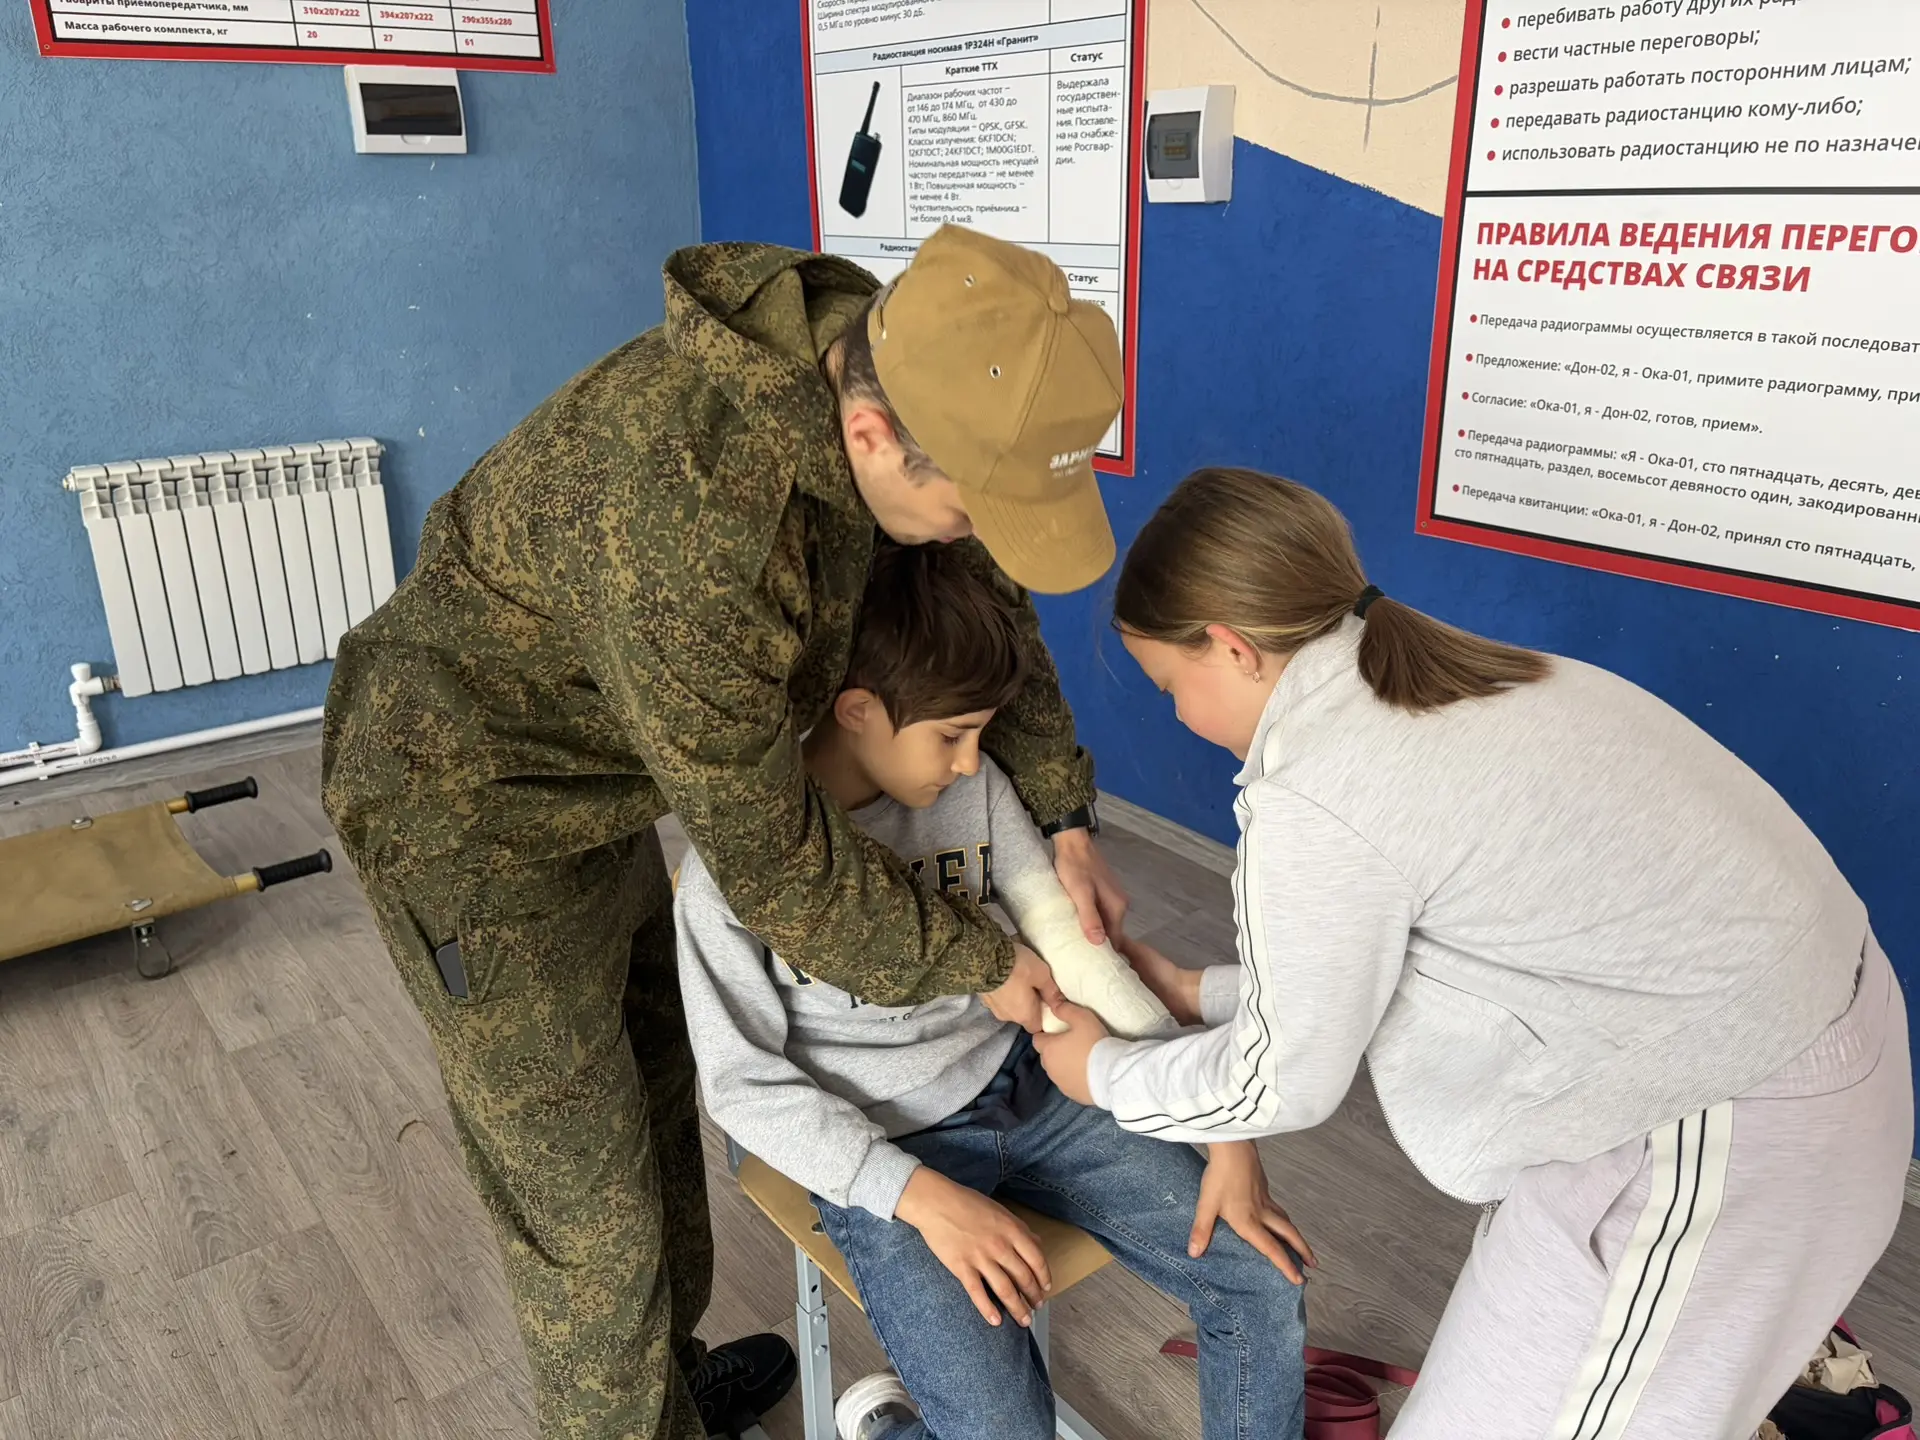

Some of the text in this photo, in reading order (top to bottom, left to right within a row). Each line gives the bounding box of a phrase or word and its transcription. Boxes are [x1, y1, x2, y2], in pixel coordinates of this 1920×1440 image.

[64, 21, 99, 30] Масса
[101, 23, 152, 33] рабочего
[1517, 7, 1615, 28] перебивать
[1620, 0, 1683, 22] работу
[307, 30, 318, 38] 20
[383, 34, 393, 42] 27
[465, 38, 474, 46] 61
[873, 49, 926, 61] Радиостанция
[927, 44, 962, 54] носимая
[996, 35, 1039, 47] «Гранит»
[1514, 30, 1760, 61] вести частные переговоры;
[945, 62, 998, 76] Краткие ТТХ
[1070, 52, 1103, 63] Статус
[1509, 57, 1912, 99] разрешать работать посторонним лицам;
[1506, 96, 1863, 130] передавать радиостанцию кому-либо;
[1502, 137, 1920, 161] использовать радиостанцию не по назначе
[1477, 222, 1920, 253] ПРАВИЛА ВЕДЕНИЯ ПЕРЕГО
[1067, 273, 1098, 285] Статус
[1473, 258, 1811, 292] НА СРЕДСТВАХ СВЯЗИ
[1480, 314, 1537, 330] Передача
[1540, 320, 1632, 335] радиограммы
[1636, 326, 1753, 341] осуществляется
[1757, 332, 1767, 342] в
[1771, 332, 1817, 346] такой
[1476, 353, 1561, 371] Предложение:
[1564, 361, 1618, 378] «Дон-02,
[1622, 368, 1630, 377] я
[1642, 367, 1692, 384] Ока-01,
[1697, 374, 1764, 388] примите
[1767, 379, 1881, 402] радиограмму,
[1472, 392, 1762, 434] Согласие: «Ока-01, я Дон-02, готов, прием».
[1468, 429, 1523, 447] Передача
[1525, 440, 1617, 460] радиограммы:
[1621, 451, 1637, 462] «Я
[1648, 453, 1698, 472] Ока-01,
[1702, 462, 1726, 473] сто
[1730, 466, 1824, 488] пятнадцать,
[1828, 478, 1888, 497] десять,
[1455, 449, 1920, 523] сто пятнадцать, раздел, восемьсот девяносто один, закодированн
[1462, 485, 1915, 571] Передача квитанции: «Ока-01, я Дон-02, принял сто пятнадцать,
